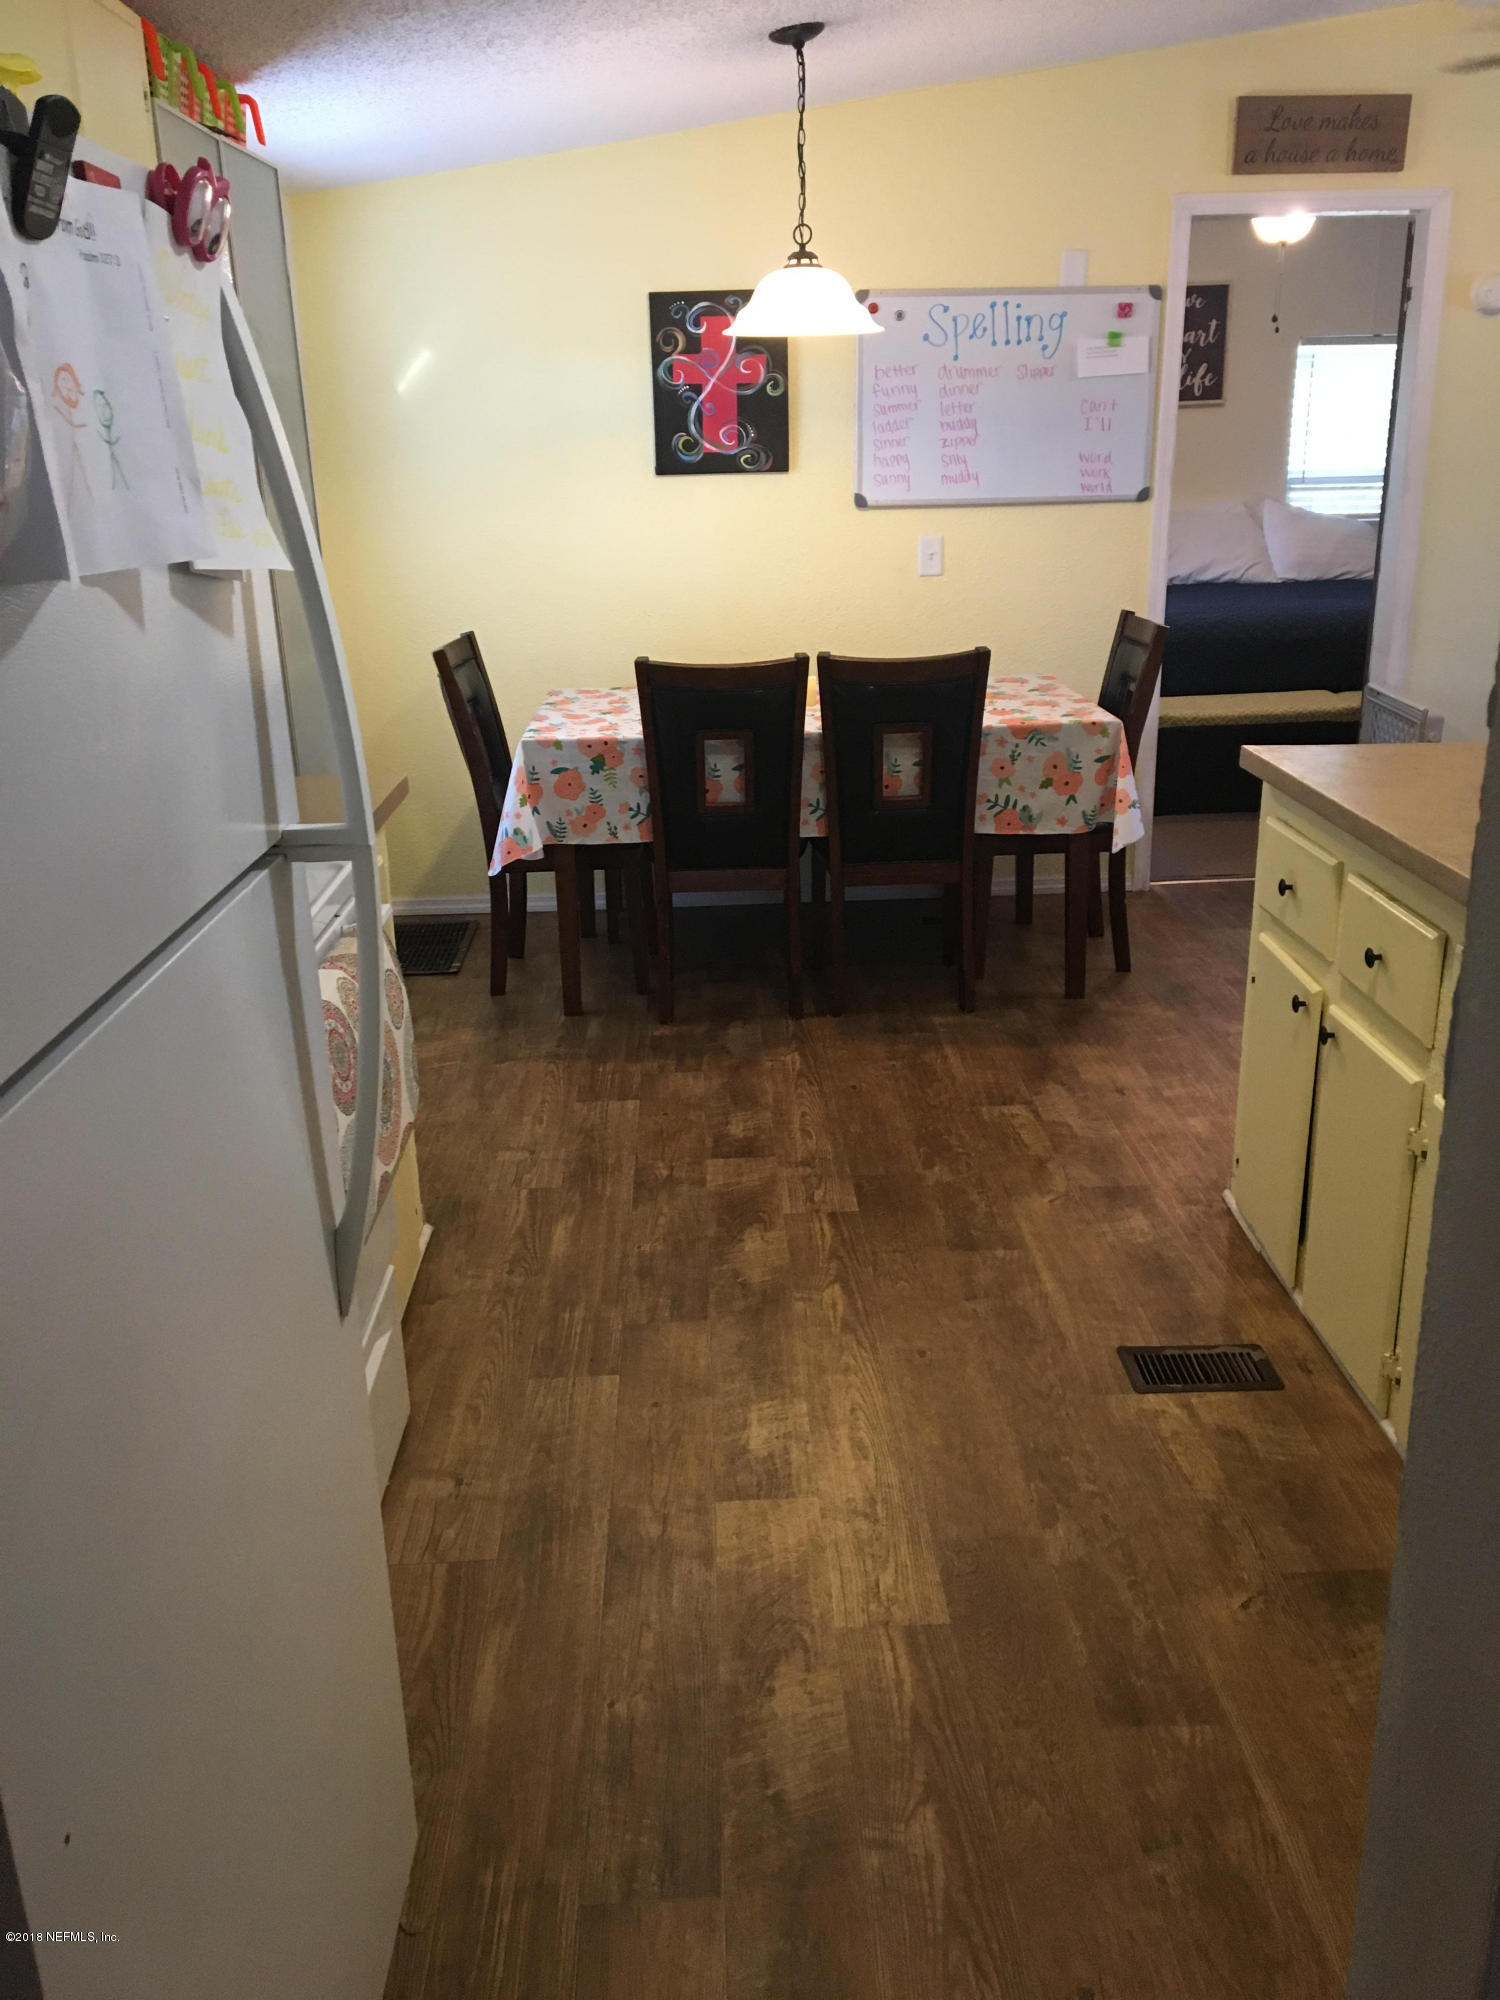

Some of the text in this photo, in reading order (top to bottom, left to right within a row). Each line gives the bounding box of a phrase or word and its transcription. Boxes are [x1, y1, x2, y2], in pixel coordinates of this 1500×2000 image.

[1263, 103, 1380, 132] Love makes
[1243, 149, 1257, 164] a
[1264, 137, 1321, 164] house
[1325, 149, 1338, 163] a
[1185, 293, 1207, 308] ve
[922, 300, 1068, 361] Spelling
[1183, 318, 1222, 347] art
[874, 363, 919, 380] better
[937, 362, 1003, 380] drummer
[872, 383, 920, 401] funny
[939, 382, 983, 399] dinner
[940, 400, 976, 416] letter
[872, 417, 914, 433] ladder
[873, 453, 911, 473] happy
